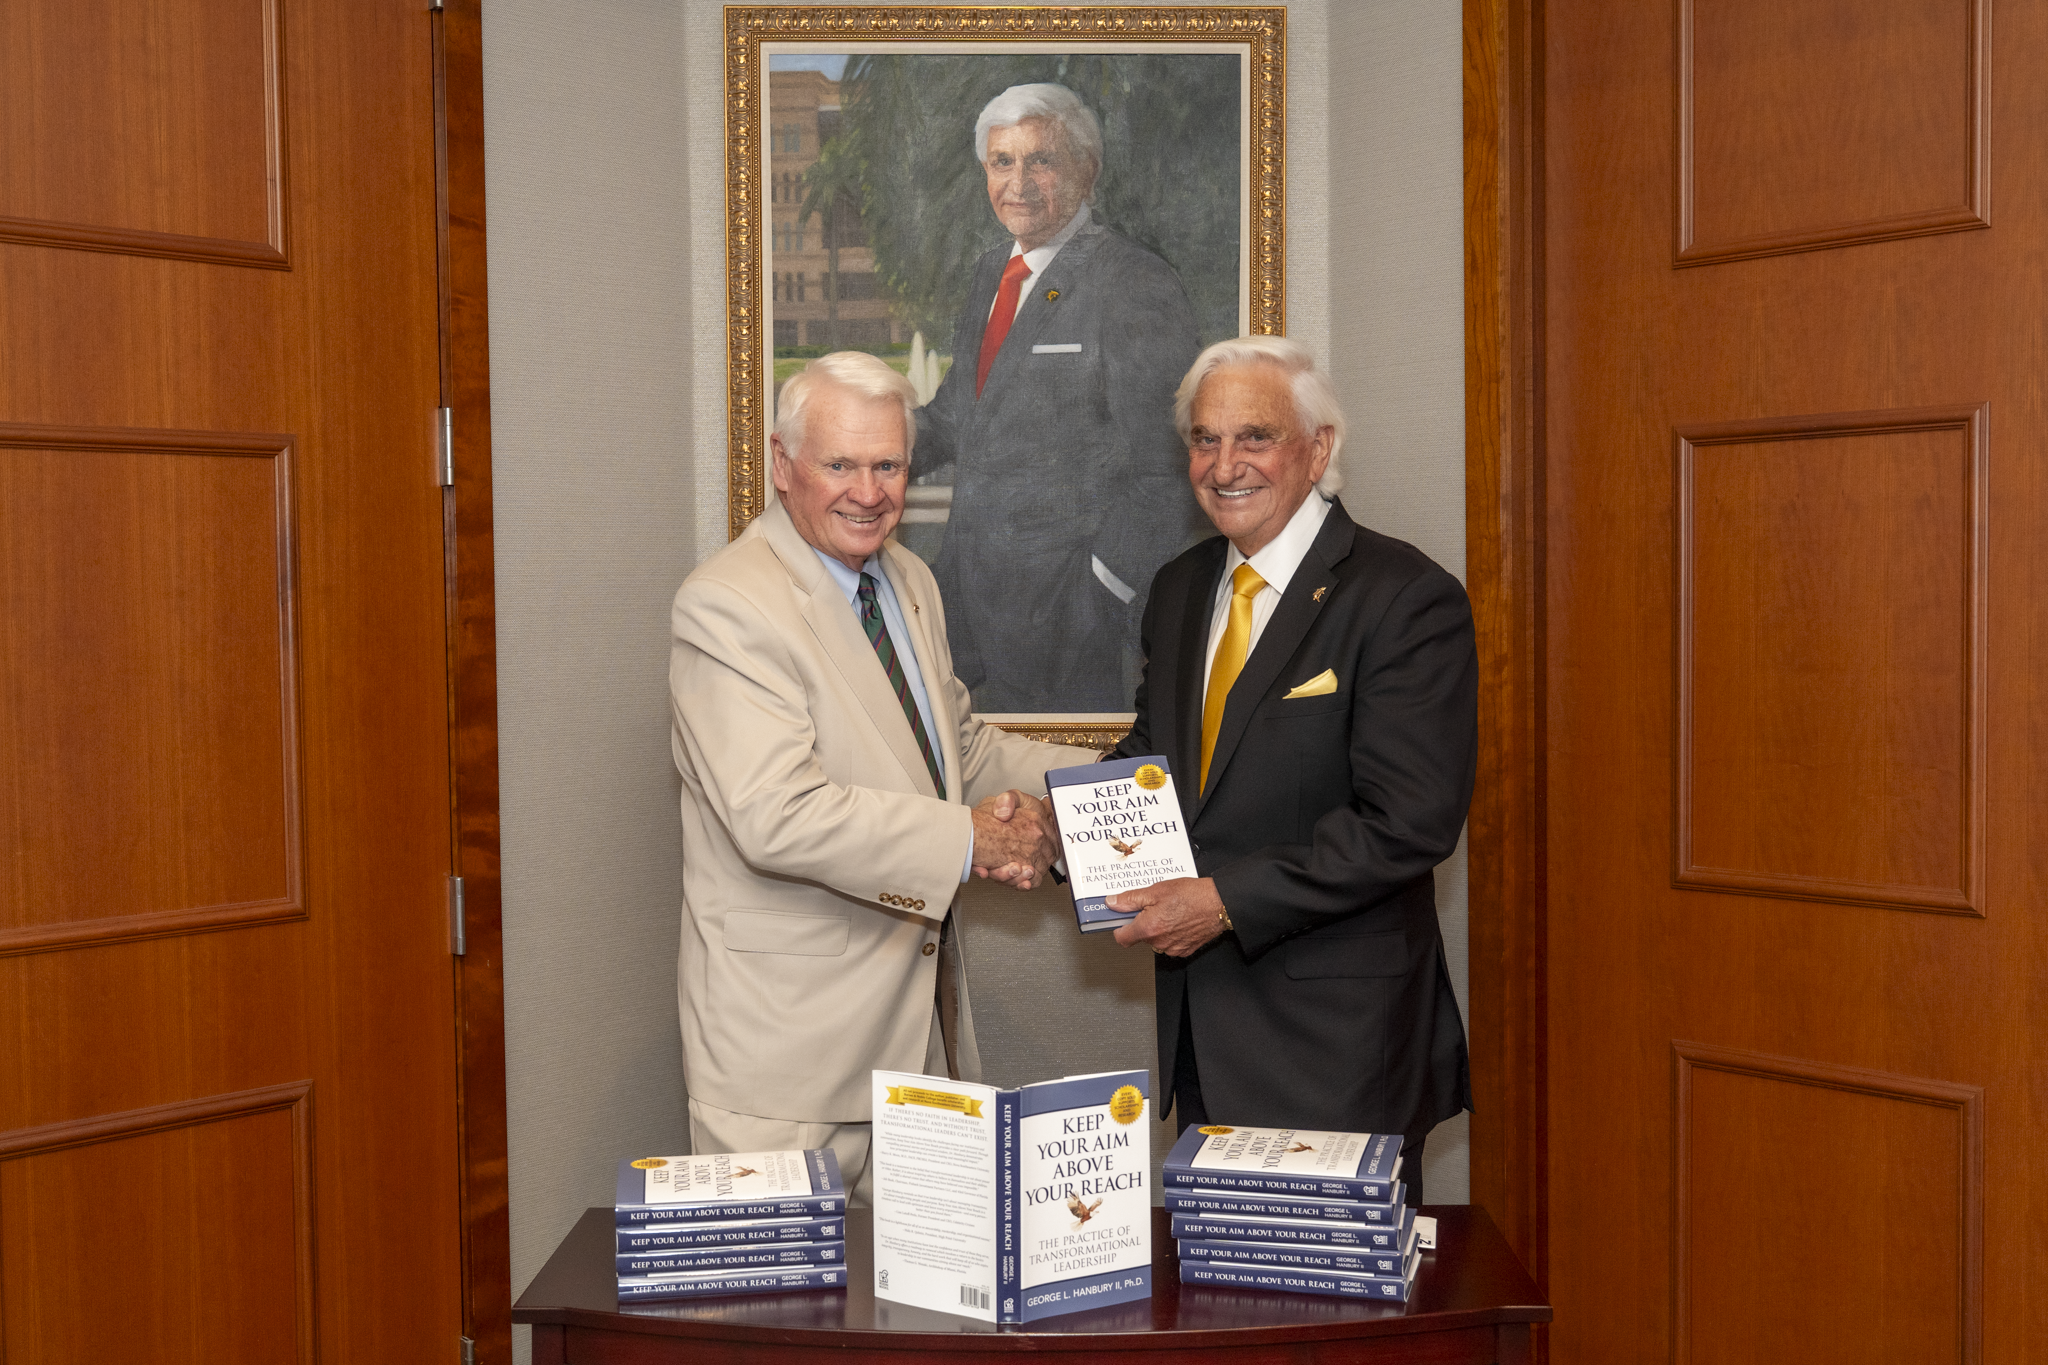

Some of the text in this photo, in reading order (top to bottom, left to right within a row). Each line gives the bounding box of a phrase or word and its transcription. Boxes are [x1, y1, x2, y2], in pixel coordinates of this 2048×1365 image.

[1094, 783, 1132, 798] KEEP
[1072, 794, 1159, 814] YOUR AIM
[1092, 810, 1147, 827] ABOVE
[1066, 821, 1178, 844] YOUR REACH
[1081, 866, 1186, 883] TRANSFORMATIONAL
[1087, 865, 1107, 873] THE
[1111, 859, 1157, 871] PRACTICE
[1105, 877, 1165, 889] LEADERSHIP
[1063, 1113, 1105, 1135] KEEP
[1004, 1126, 1012, 1149] YOUR
[1037, 1131, 1130, 1160] YOUR AIM
[1208, 1137, 1229, 1150] KEEP
[1223, 1131, 1255, 1160] YOUR AIM
[1248, 1137, 1271, 1156] ABOVE
[1004, 1150, 1012, 1167] AIM
[1262, 1130, 1296, 1168] YOUR REACH
[674, 1160, 690, 1192] YOUR AIM
[695, 1164, 711, 1184] ABOVE
[714, 1155, 732, 1196] YOUR REACH
[1053, 1155, 1113, 1179] ABOVE
[654, 1170, 669, 1184] KEEP
[1004, 1169, 1012, 1196] ABOVE
[1176, 1175, 1317, 1191] KEEP YOUR AIM ABOVE YOUR REACH
[1025, 1171, 1142, 1206] YOUR REACH
[630, 1206, 774, 1220] KEEP YOUR AIM ABOVE YOUR REACH
[1004, 1198, 1012, 1221] YOUR
[1178, 1200, 1197, 1208] KEEP
[1198, 1201, 1220, 1209] YOUR
[1240, 1204, 1266, 1212] ABOVE
[1267, 1205, 1290, 1214] YOUR
[1292, 1207, 1319, 1215] REACH
[631, 1238, 650, 1246] KEEP
[652, 1236, 675, 1245] YOUR
[695, 1234, 721, 1242] ABOVE
[748, 1231, 775, 1239] REACH
[1039, 1225, 1131, 1250] THE PRACTICE OF
[1185, 1224, 1326, 1240] KEEP YOUR AIM ABOVE YOUR REACH
[1029, 1236, 1141, 1265] TRANSFORMATIONAL
[1190, 1248, 1331, 1265] KEEP YOUR AIM ABOVE YOUR REACH
[631, 1261, 650, 1269] KEEP
[652, 1260, 675, 1268] YOUR
[695, 1257, 721, 1265] ABOVE
[723, 1256, 746, 1264] YOUR
[1054, 1253, 1117, 1273] LEADERSHIP
[633, 1279, 776, 1294] KEEP YOUR AIM ABOVE YOUR REACH
[1194, 1271, 1213, 1279] KEEP
[1214, 1273, 1237, 1281] YOUR
[1256, 1276, 1282, 1285] ABOVE
[1284, 1278, 1306, 1287] YOUR
[1308, 1280, 1335, 1289] REACH
[1027, 1293, 1061, 1307] GEORGE
[1063, 1291, 1071, 1299] L.
[1073, 1282, 1113, 1298] HANBURY
[1125, 1278, 1144, 1288] Ph.D.
